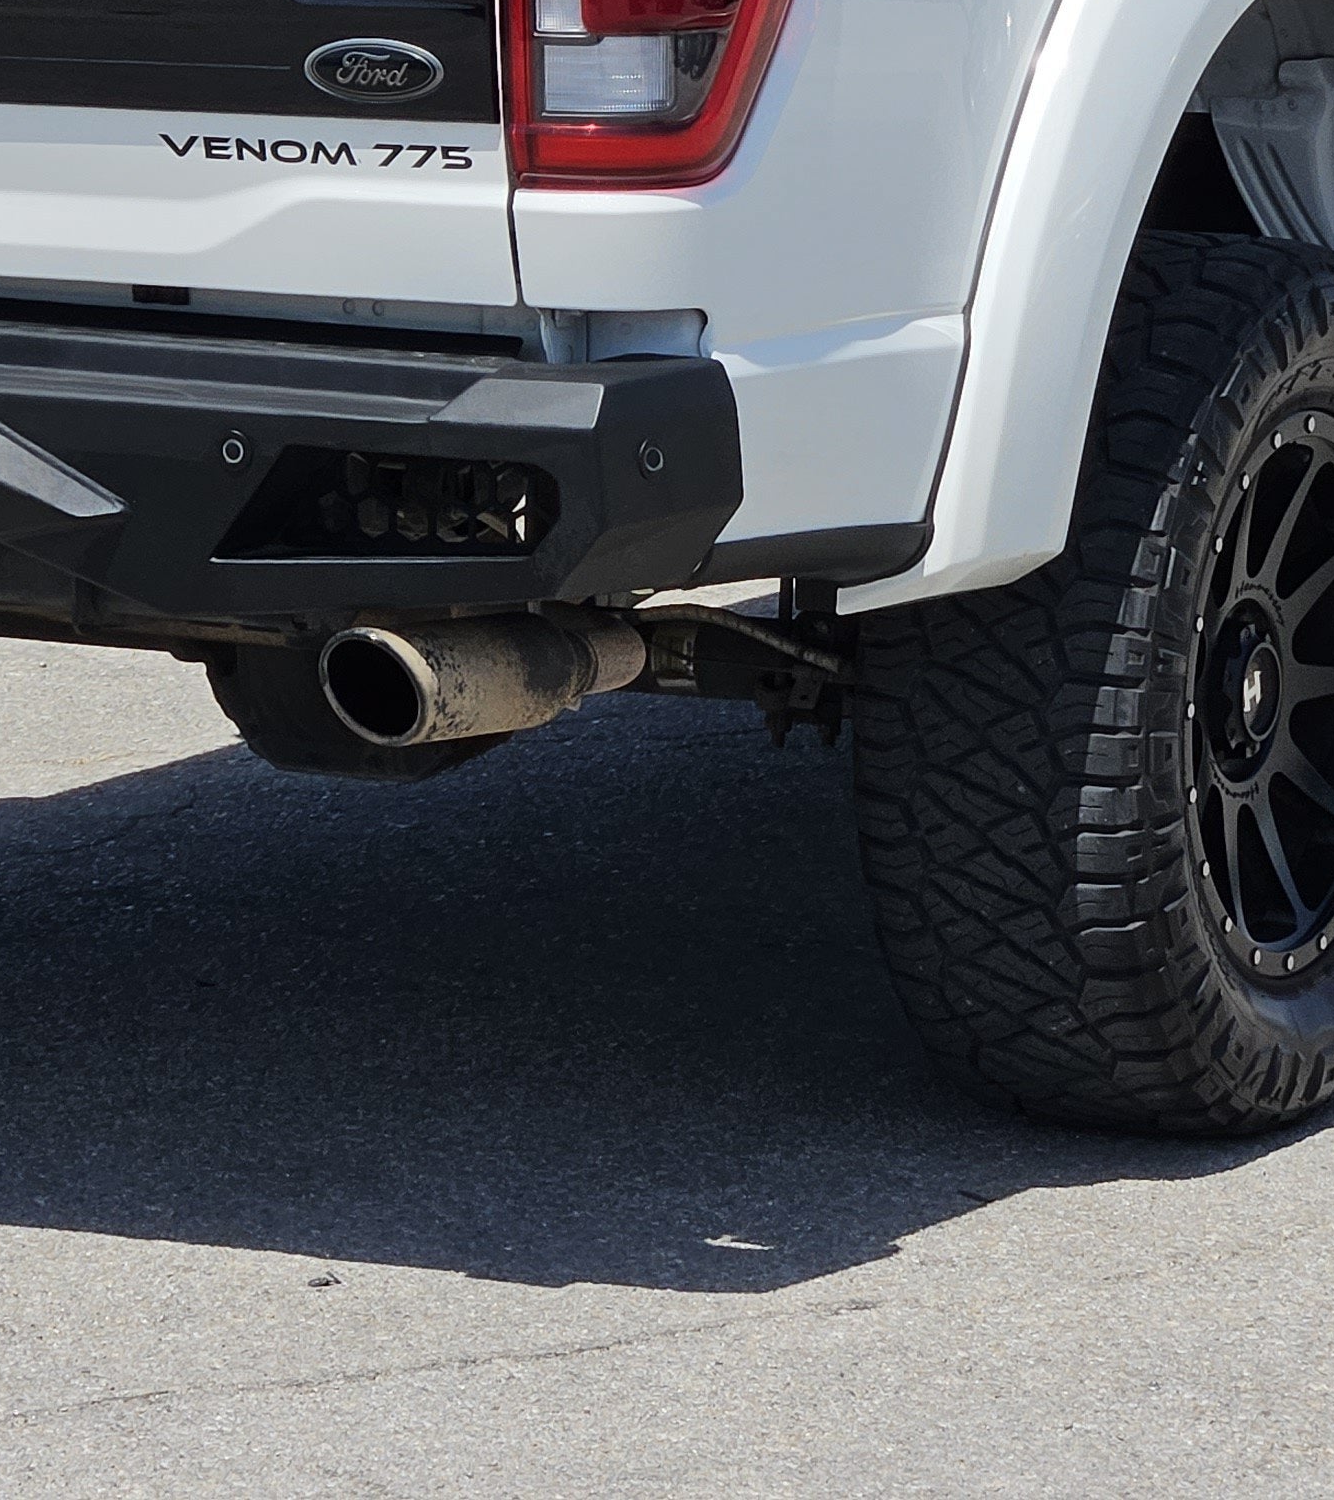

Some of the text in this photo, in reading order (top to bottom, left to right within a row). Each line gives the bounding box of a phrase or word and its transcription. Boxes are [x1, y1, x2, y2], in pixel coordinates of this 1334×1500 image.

[335, 50, 409, 89] Ford
[158, 132, 474, 170] VENOM 775
[1242, 670, 1262, 712] H
